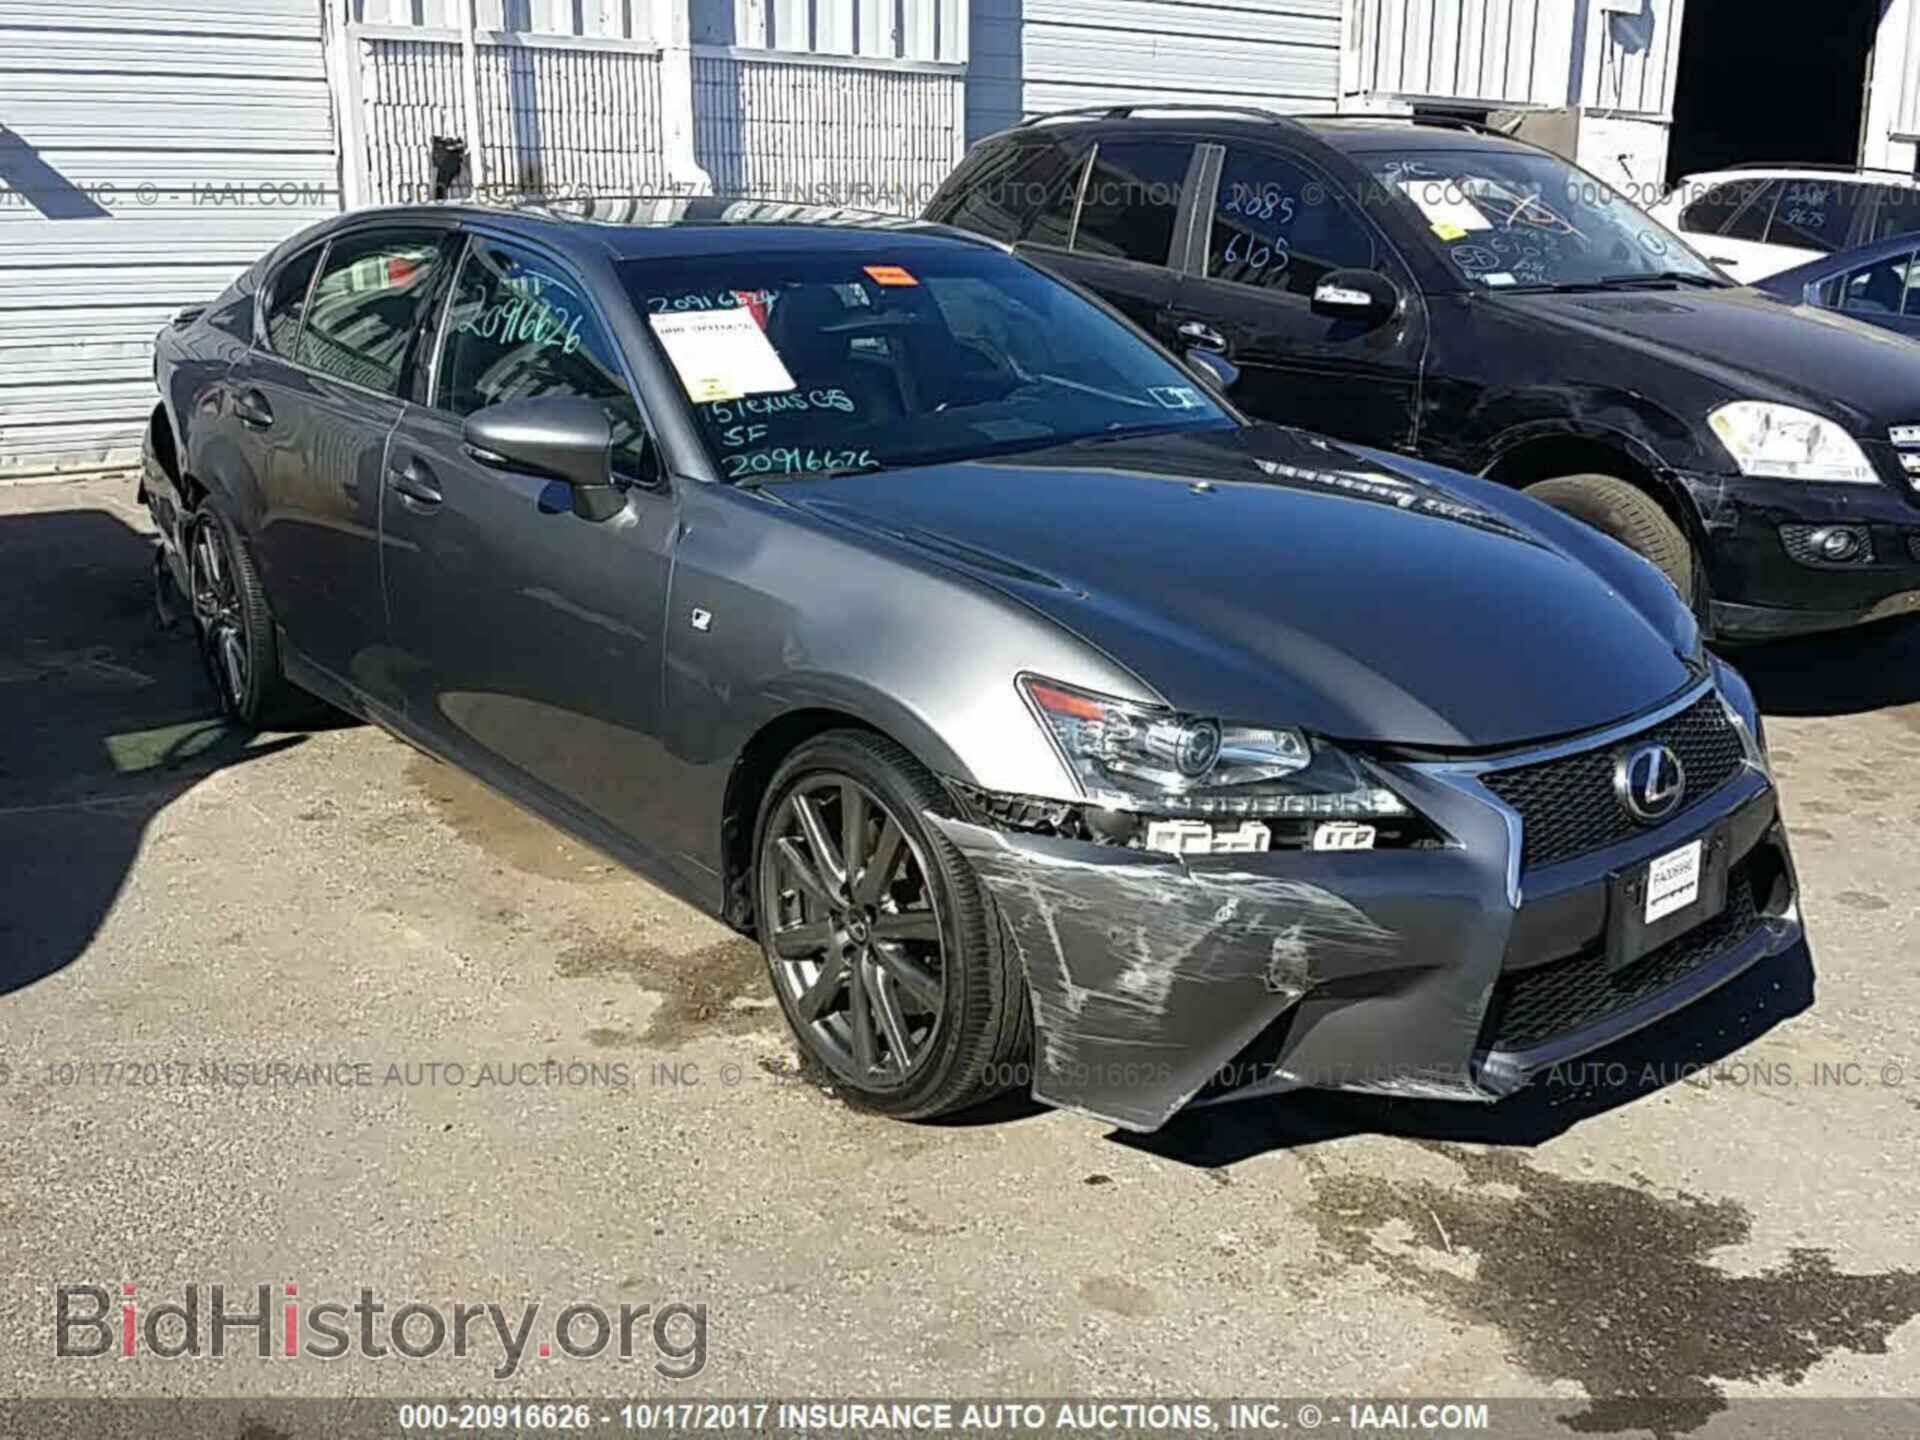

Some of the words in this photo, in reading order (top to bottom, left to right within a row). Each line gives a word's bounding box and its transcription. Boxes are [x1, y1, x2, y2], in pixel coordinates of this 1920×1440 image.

[1226, 183, 1294, 224] 2085
[1225, 232, 1289, 272] 6105
[722, 424, 768, 446] SF
